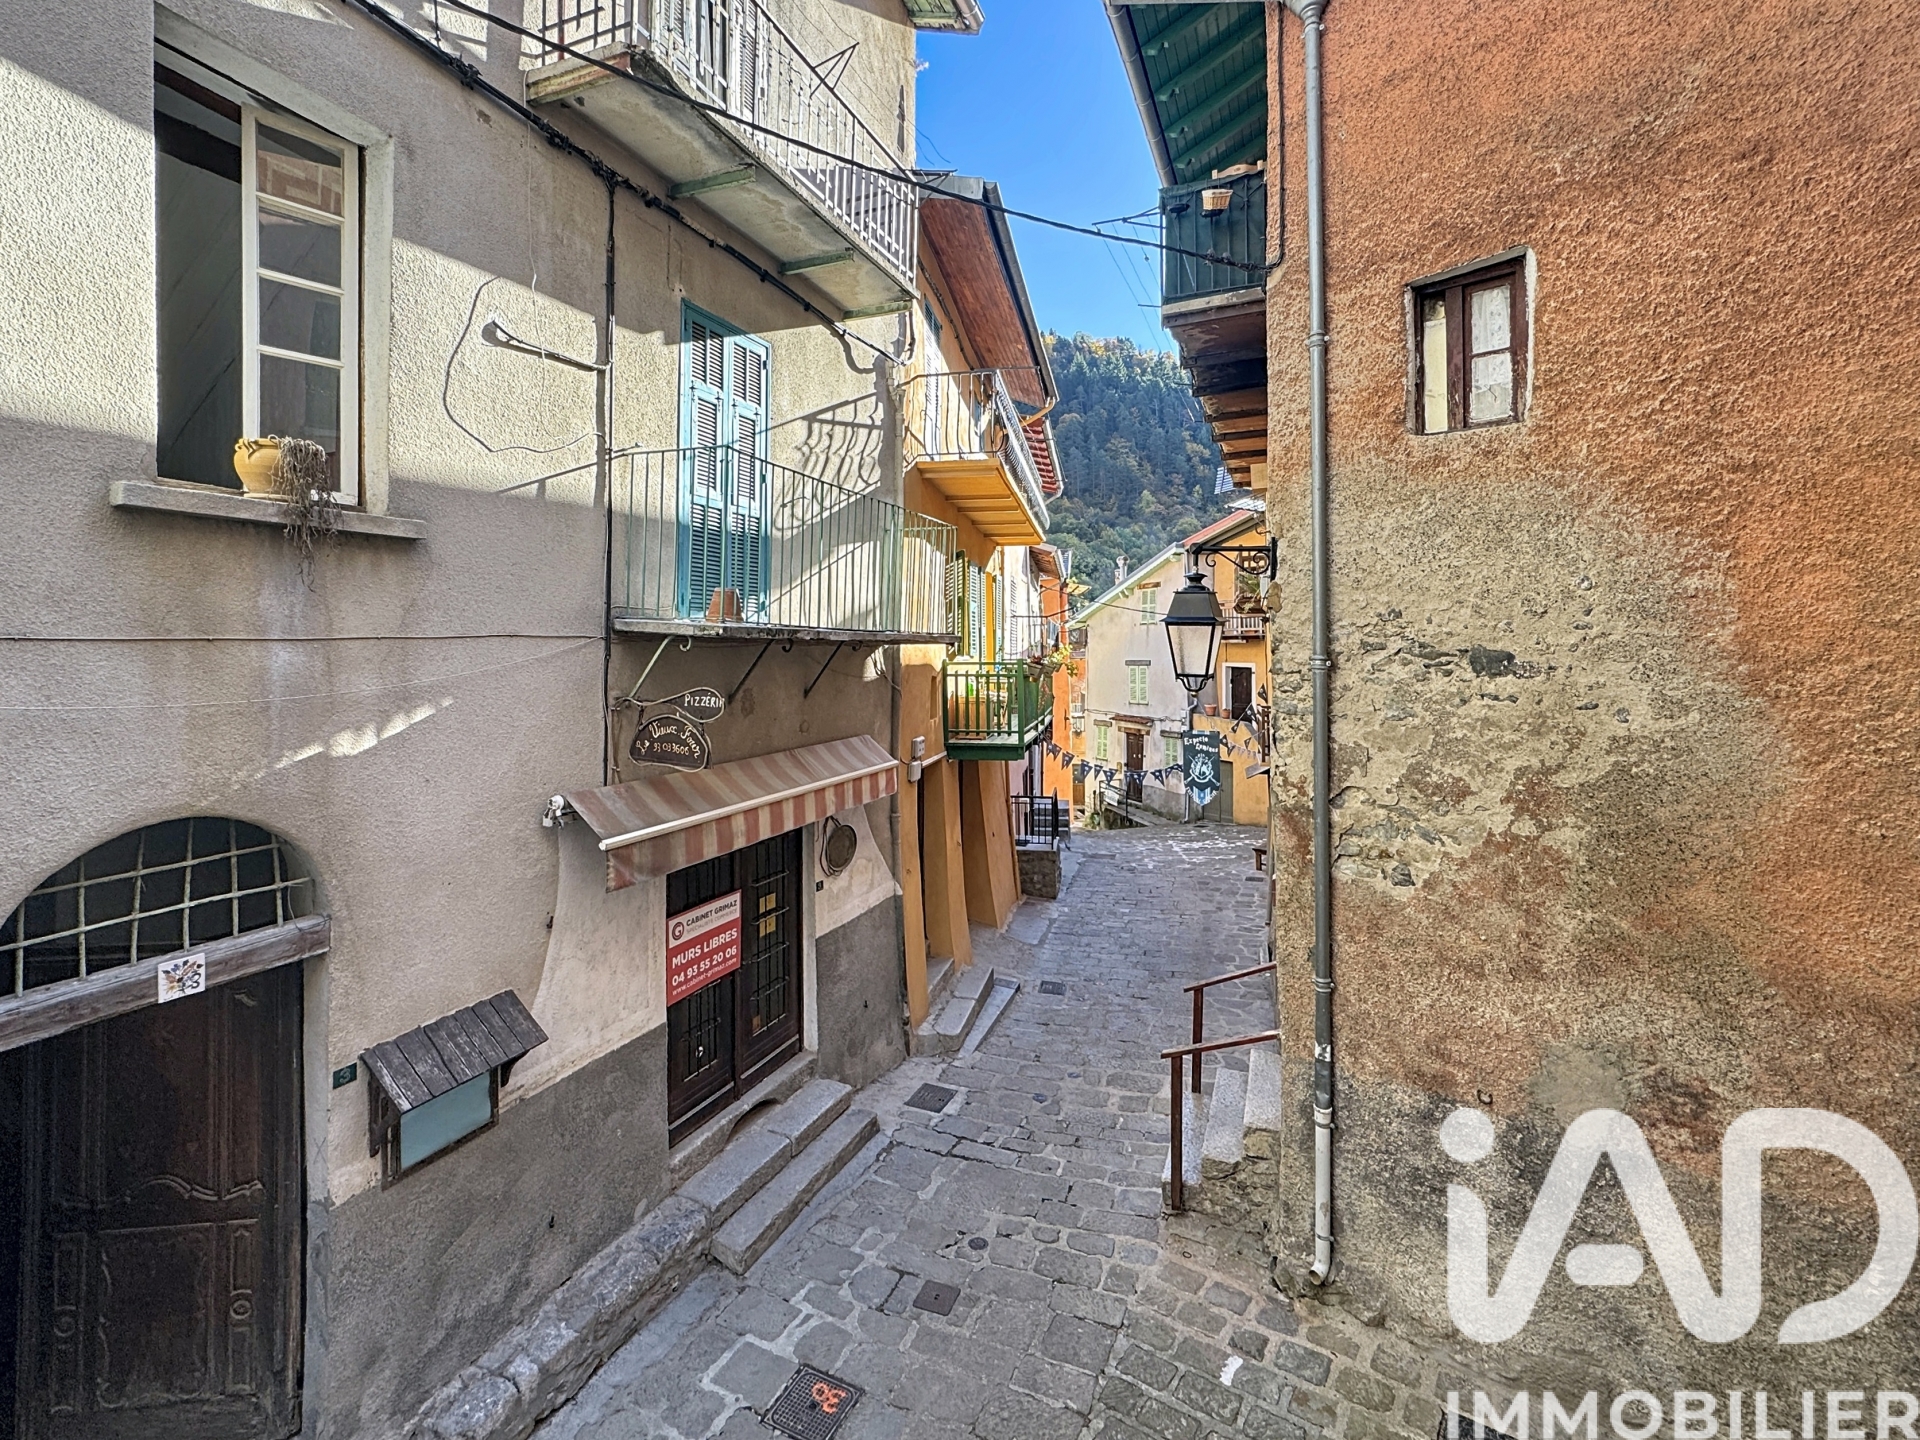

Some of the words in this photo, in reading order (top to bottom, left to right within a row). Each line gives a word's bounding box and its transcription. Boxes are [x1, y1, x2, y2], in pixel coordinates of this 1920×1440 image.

[686, 910, 713, 927] CABINET
[714, 900, 738, 914] GRIMAZ
[672, 945, 702, 969] MURS
[703, 928, 738, 953] LIBRES
[672, 971, 685, 986] 04
[687, 965, 698, 979] 93
[699, 959, 711, 972] 55
[712, 952, 724, 965] 20
[725, 945, 738, 958] 06
[672, 957, 738, 996] www.cabinet-grimaz.com
[339, 1067, 350, 1084] 3
